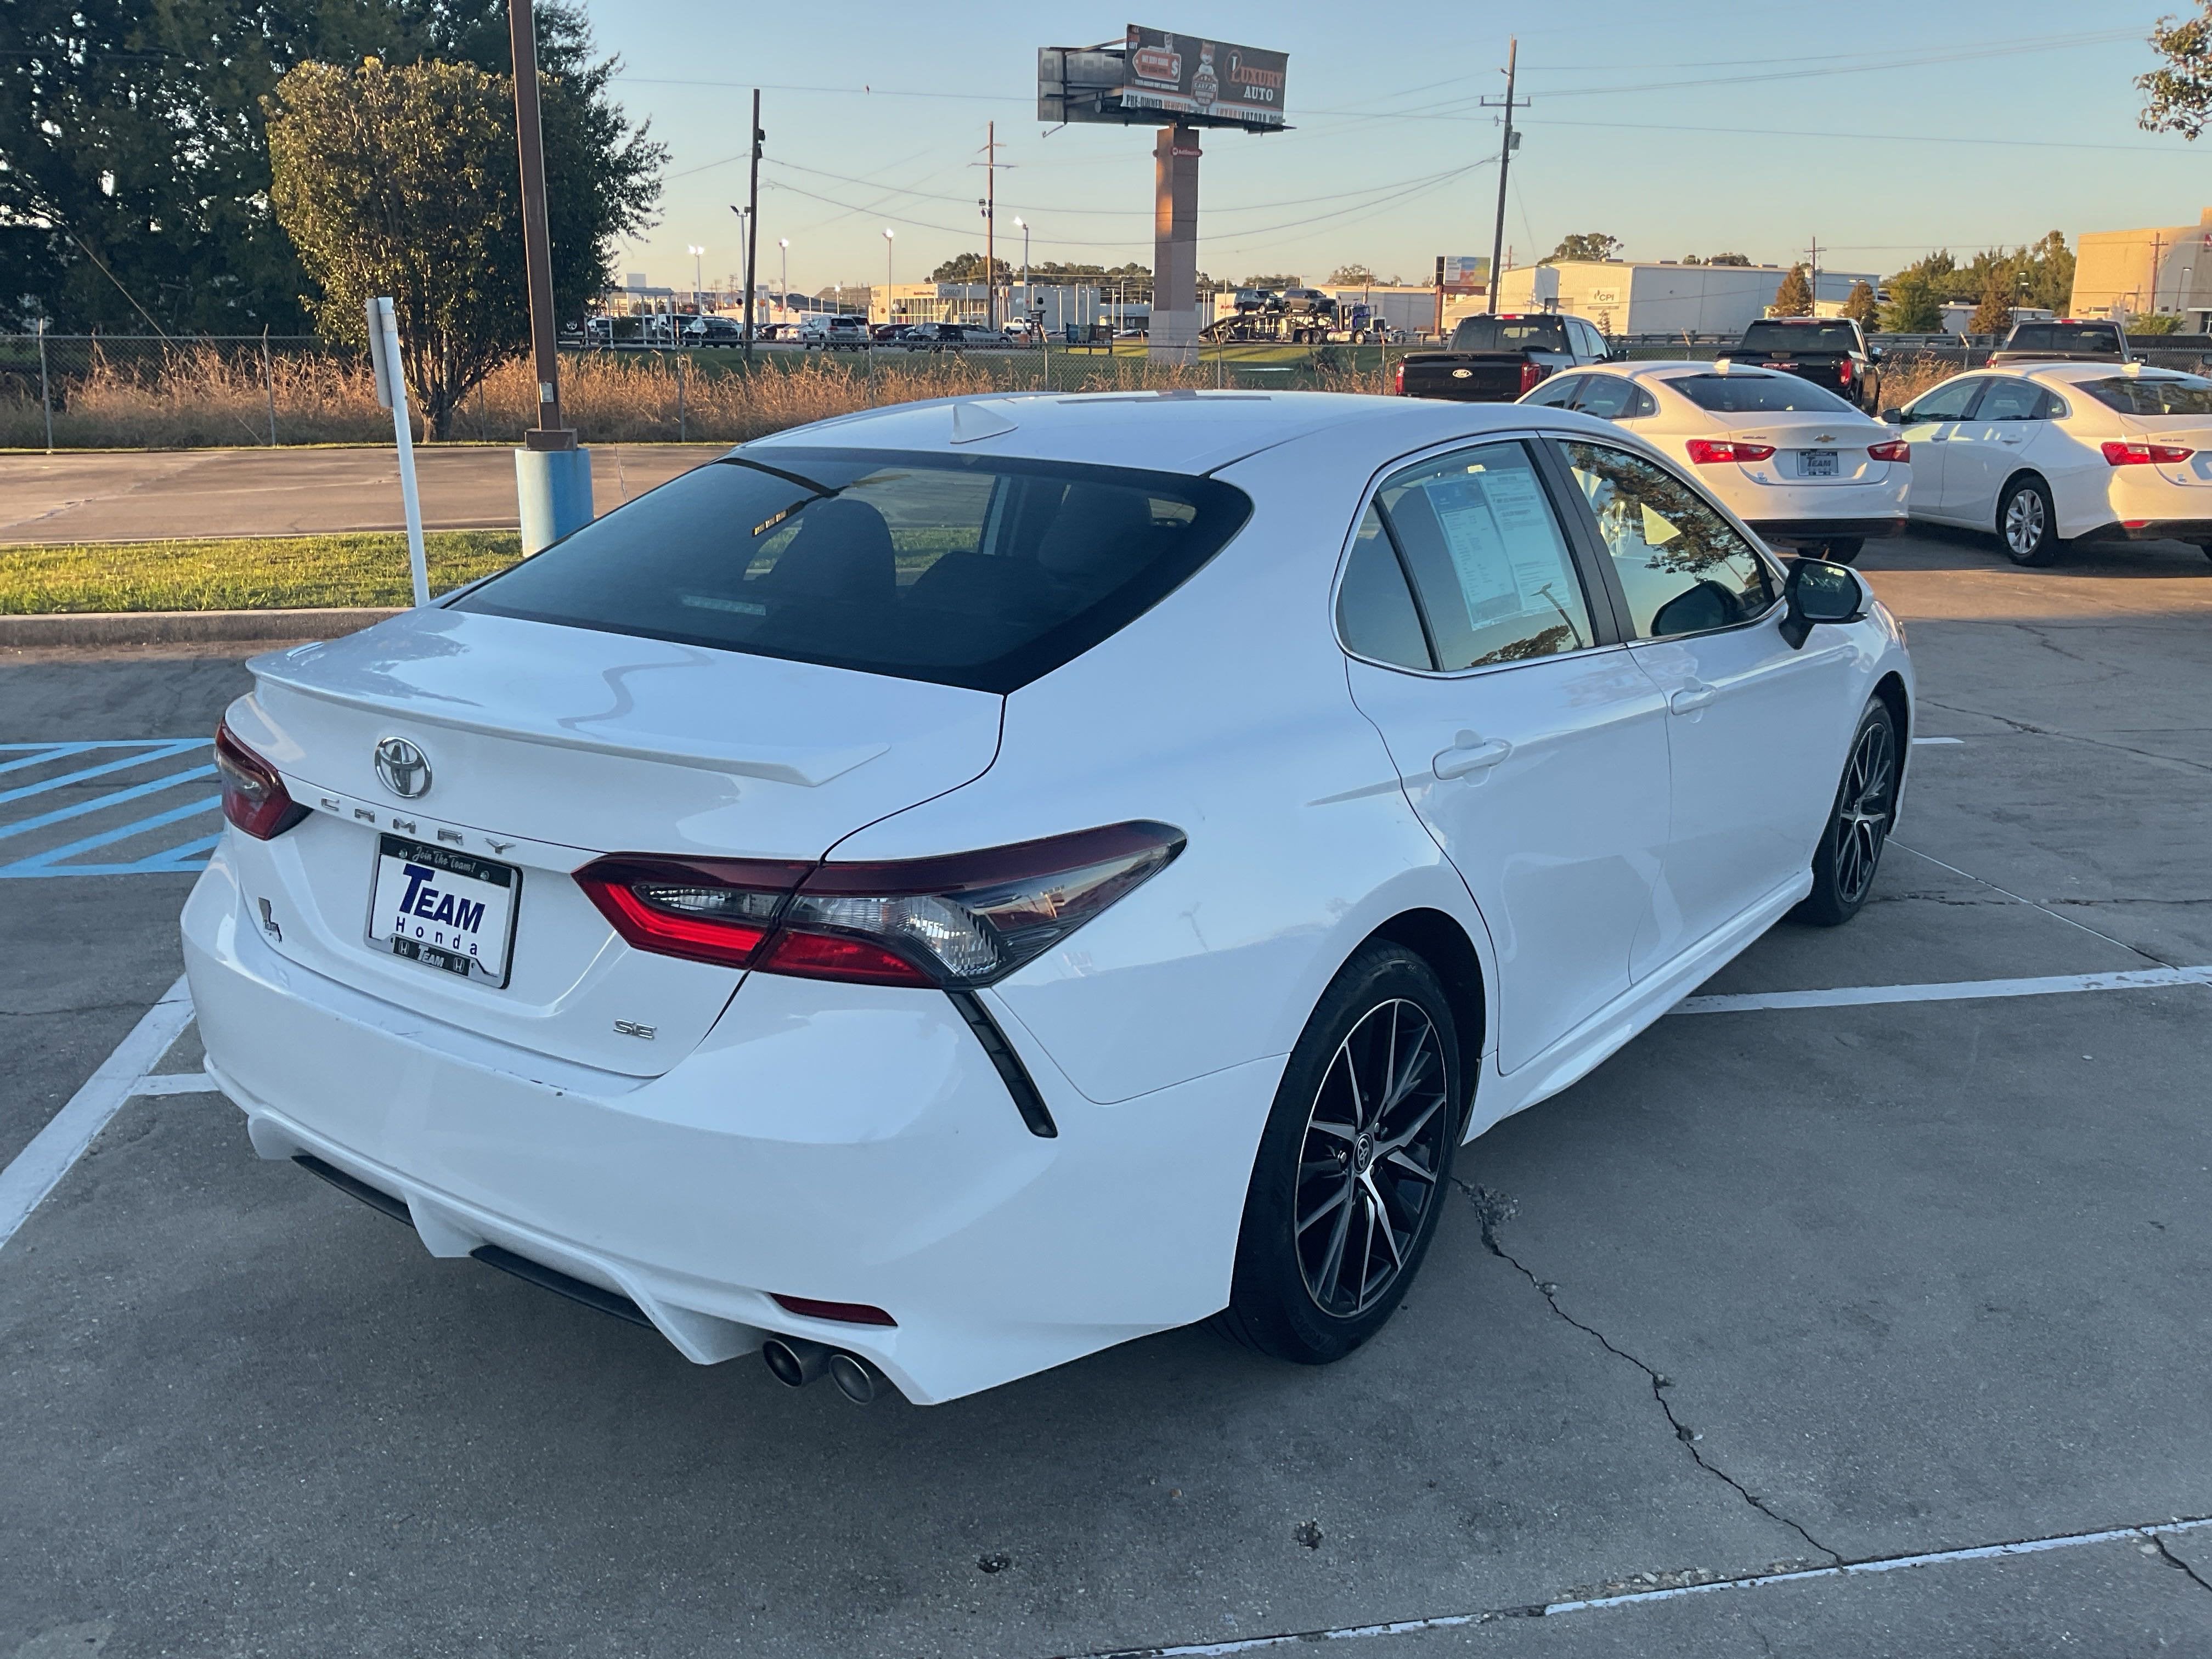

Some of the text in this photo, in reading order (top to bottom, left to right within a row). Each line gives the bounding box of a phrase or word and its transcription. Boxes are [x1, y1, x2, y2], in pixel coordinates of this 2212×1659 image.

[1229, 56, 1283, 88] LUXURY
[1243, 86, 1273, 101] AUTO
[1599, 294, 1615, 302] CPI
[1806, 456, 1831, 467] TEAM
[320, 797, 517, 854] CAMRY
[412, 847, 432, 861] Join
[433, 851, 448, 865] The
[399, 863, 486, 934] TEAM
[396, 916, 477, 956] Honda
[417, 944, 444, 968] TEAM
[613, 1019, 657, 1040] SE
